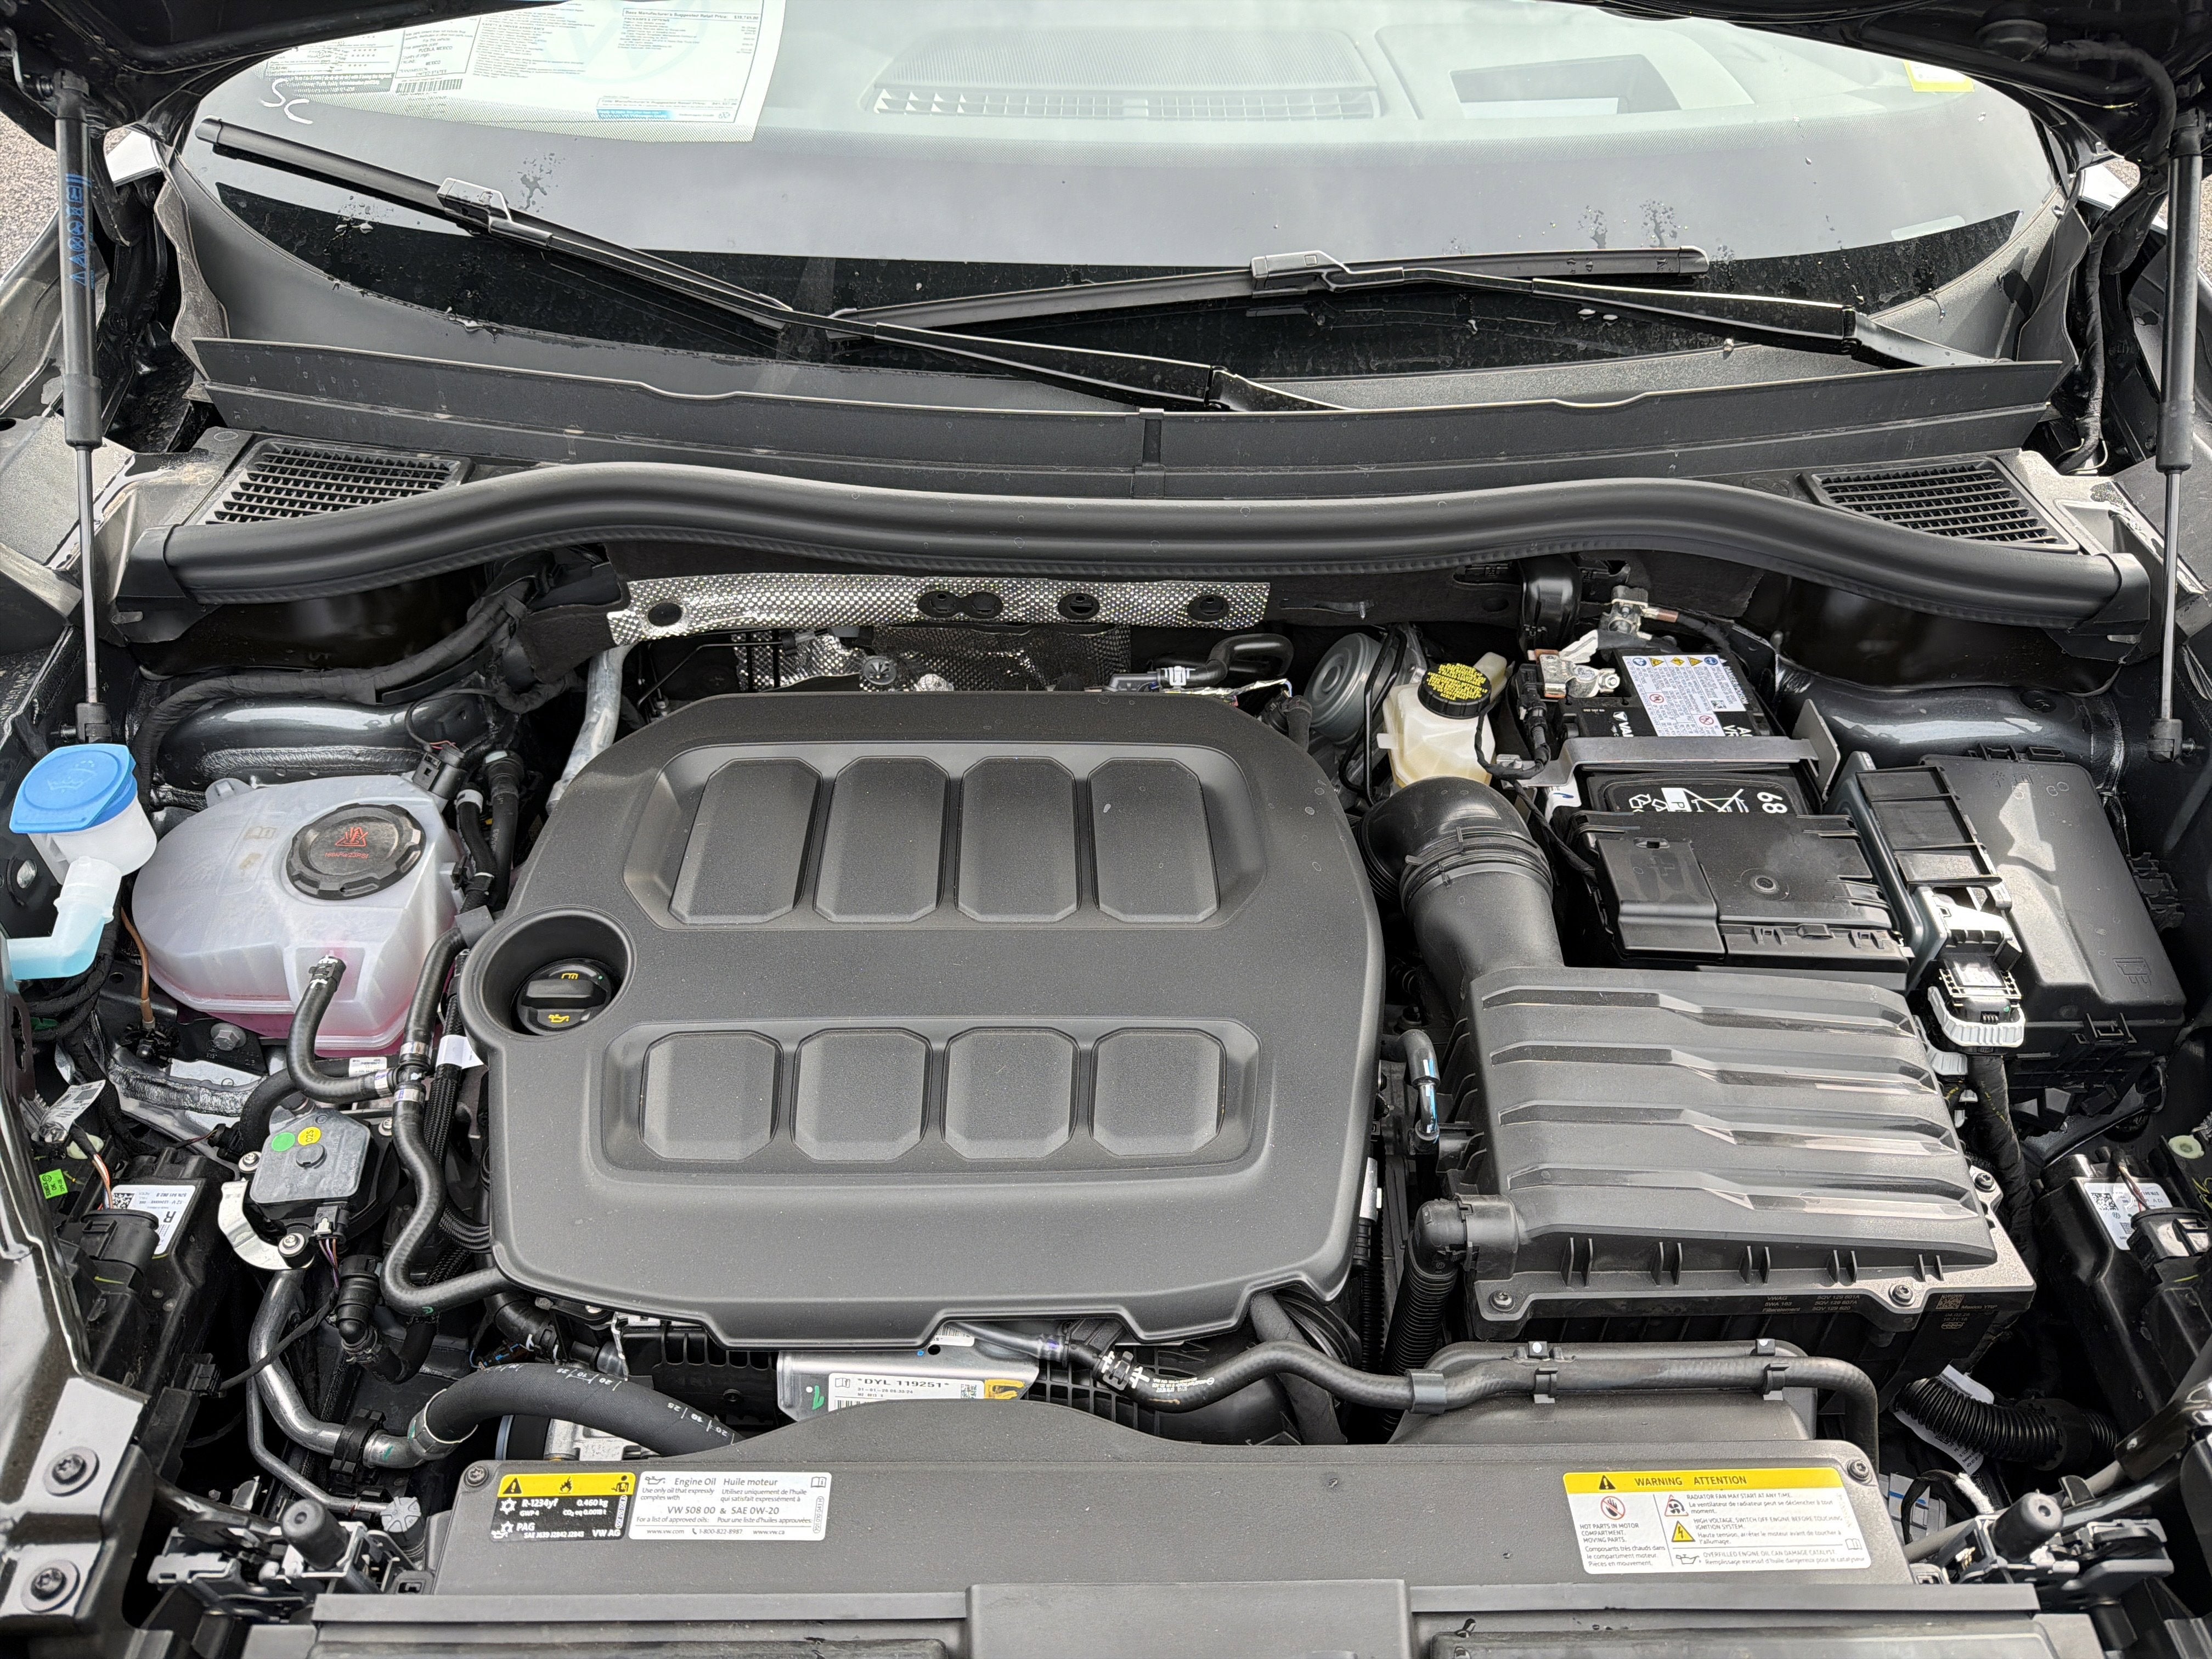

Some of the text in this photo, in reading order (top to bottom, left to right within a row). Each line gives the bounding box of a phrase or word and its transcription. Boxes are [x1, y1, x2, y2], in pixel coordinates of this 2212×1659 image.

[1757, 792, 1788, 814] 68
[163, 1211, 177, 1223] R
[674, 1477, 702, 1487] Engine
[704, 1477, 716, 1486] Oil
[1634, 1476, 1748, 1486] WARNING ATTENTION
[521, 1498, 558, 1509] R-1234yf
[599, 1498, 609, 1508] kg
[667, 1506, 684, 1514] VW
[685, 1506, 702, 1514] 508
[731, 1506, 748, 1515] SAE
[749, 1506, 780, 1515] 0W-20
[516, 1522, 535, 1532] PAG
[592, 1529, 607, 1537] VW
[607, 1529, 621, 1537] AG
